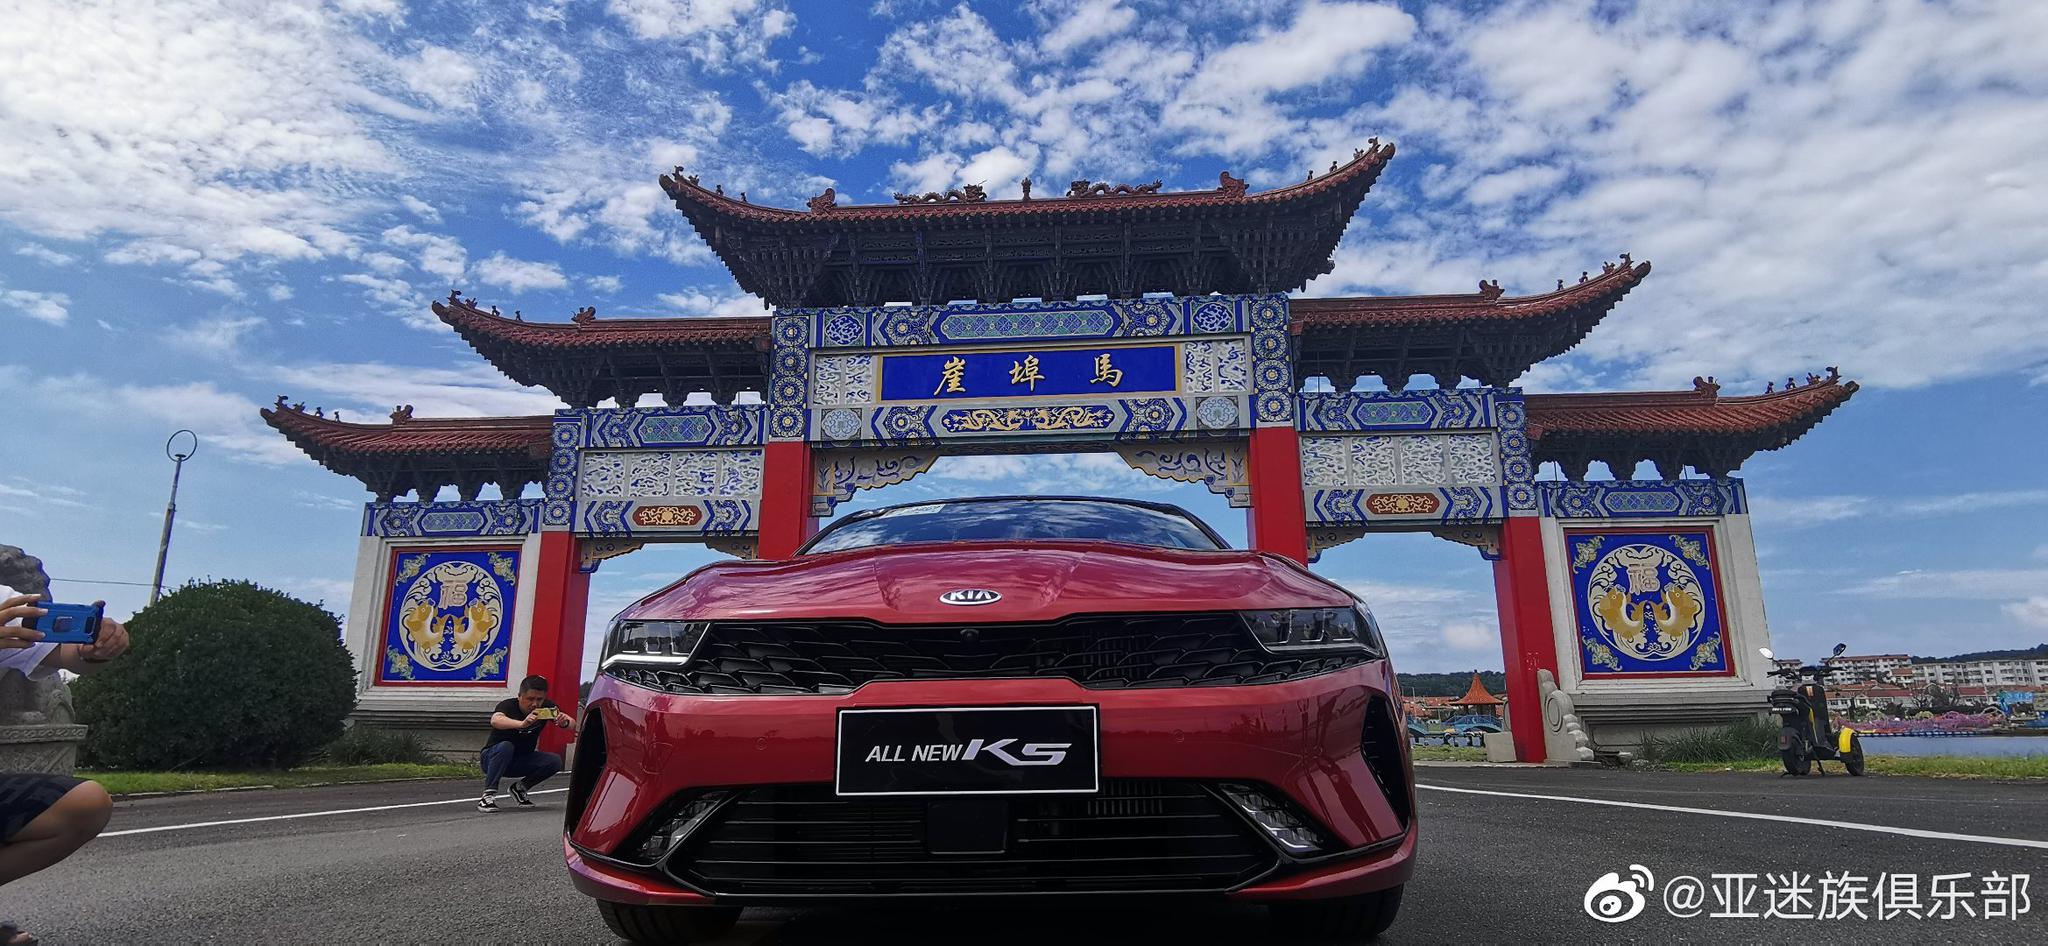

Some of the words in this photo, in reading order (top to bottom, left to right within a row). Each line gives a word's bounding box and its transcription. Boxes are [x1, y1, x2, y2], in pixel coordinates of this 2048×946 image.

[949, 589, 992, 601] KIA
[865, 744, 905, 762] ALL
[911, 744, 963, 762] NEW
